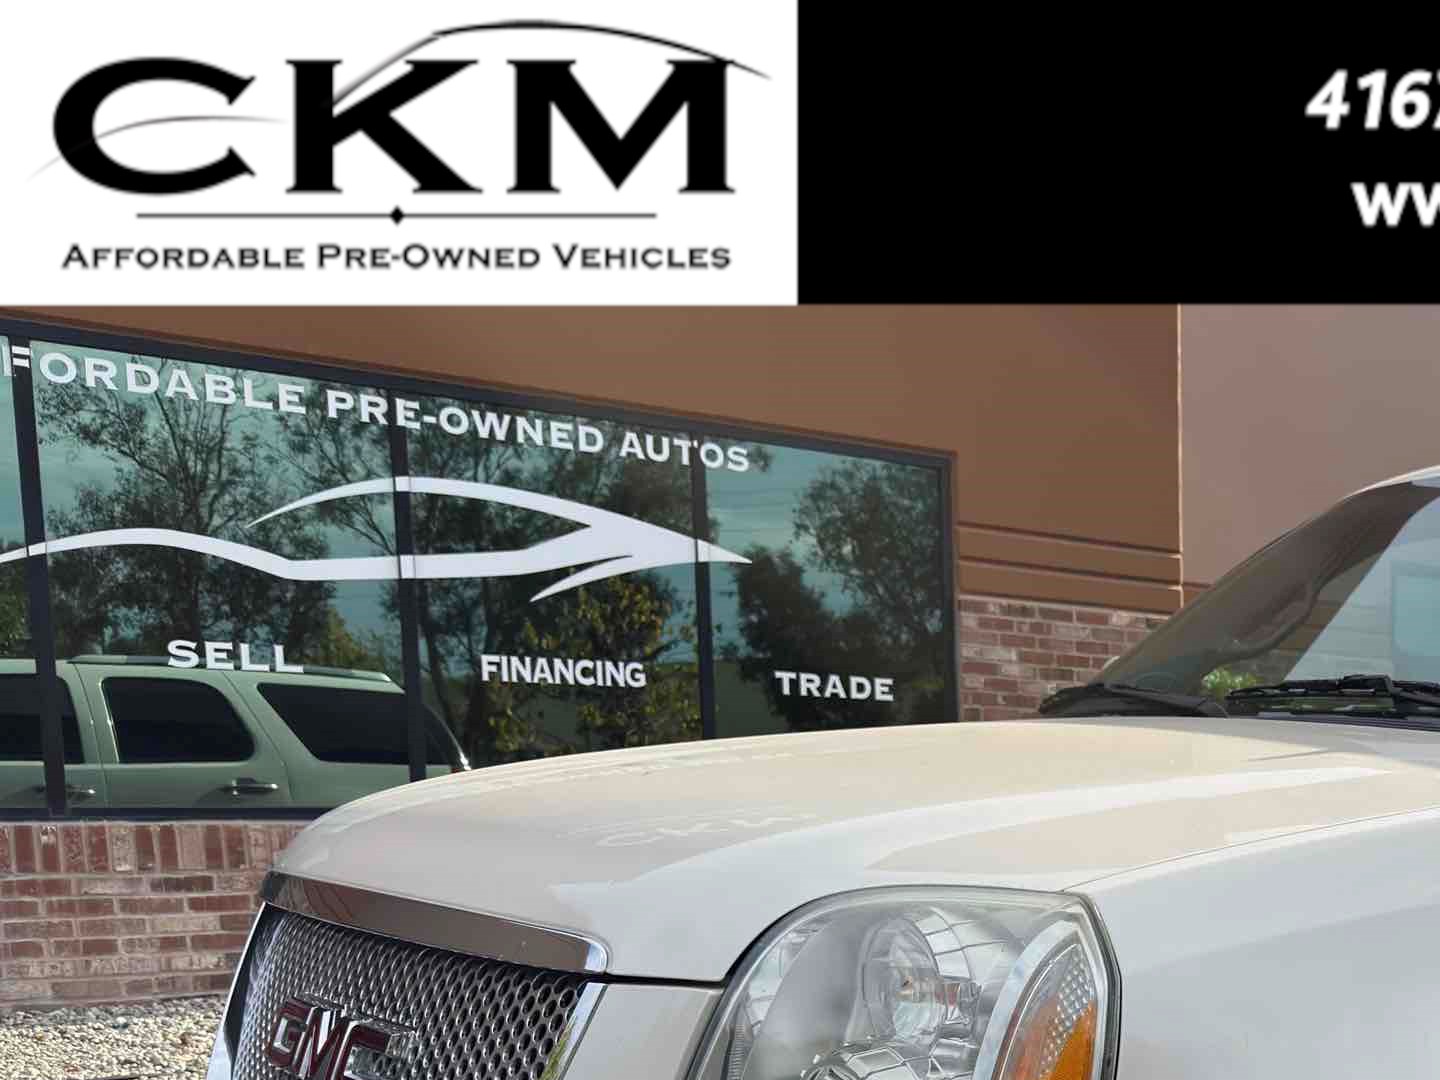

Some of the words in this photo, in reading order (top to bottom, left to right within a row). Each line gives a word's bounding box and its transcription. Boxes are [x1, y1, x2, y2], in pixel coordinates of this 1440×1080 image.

[326, 388, 604, 455] PRE-OWNED
[619, 430, 751, 473] AUTOS
[167, 639, 304, 673] SELL
[480, 654, 647, 689] FINANCING
[775, 670, 895, 702] TRADE
